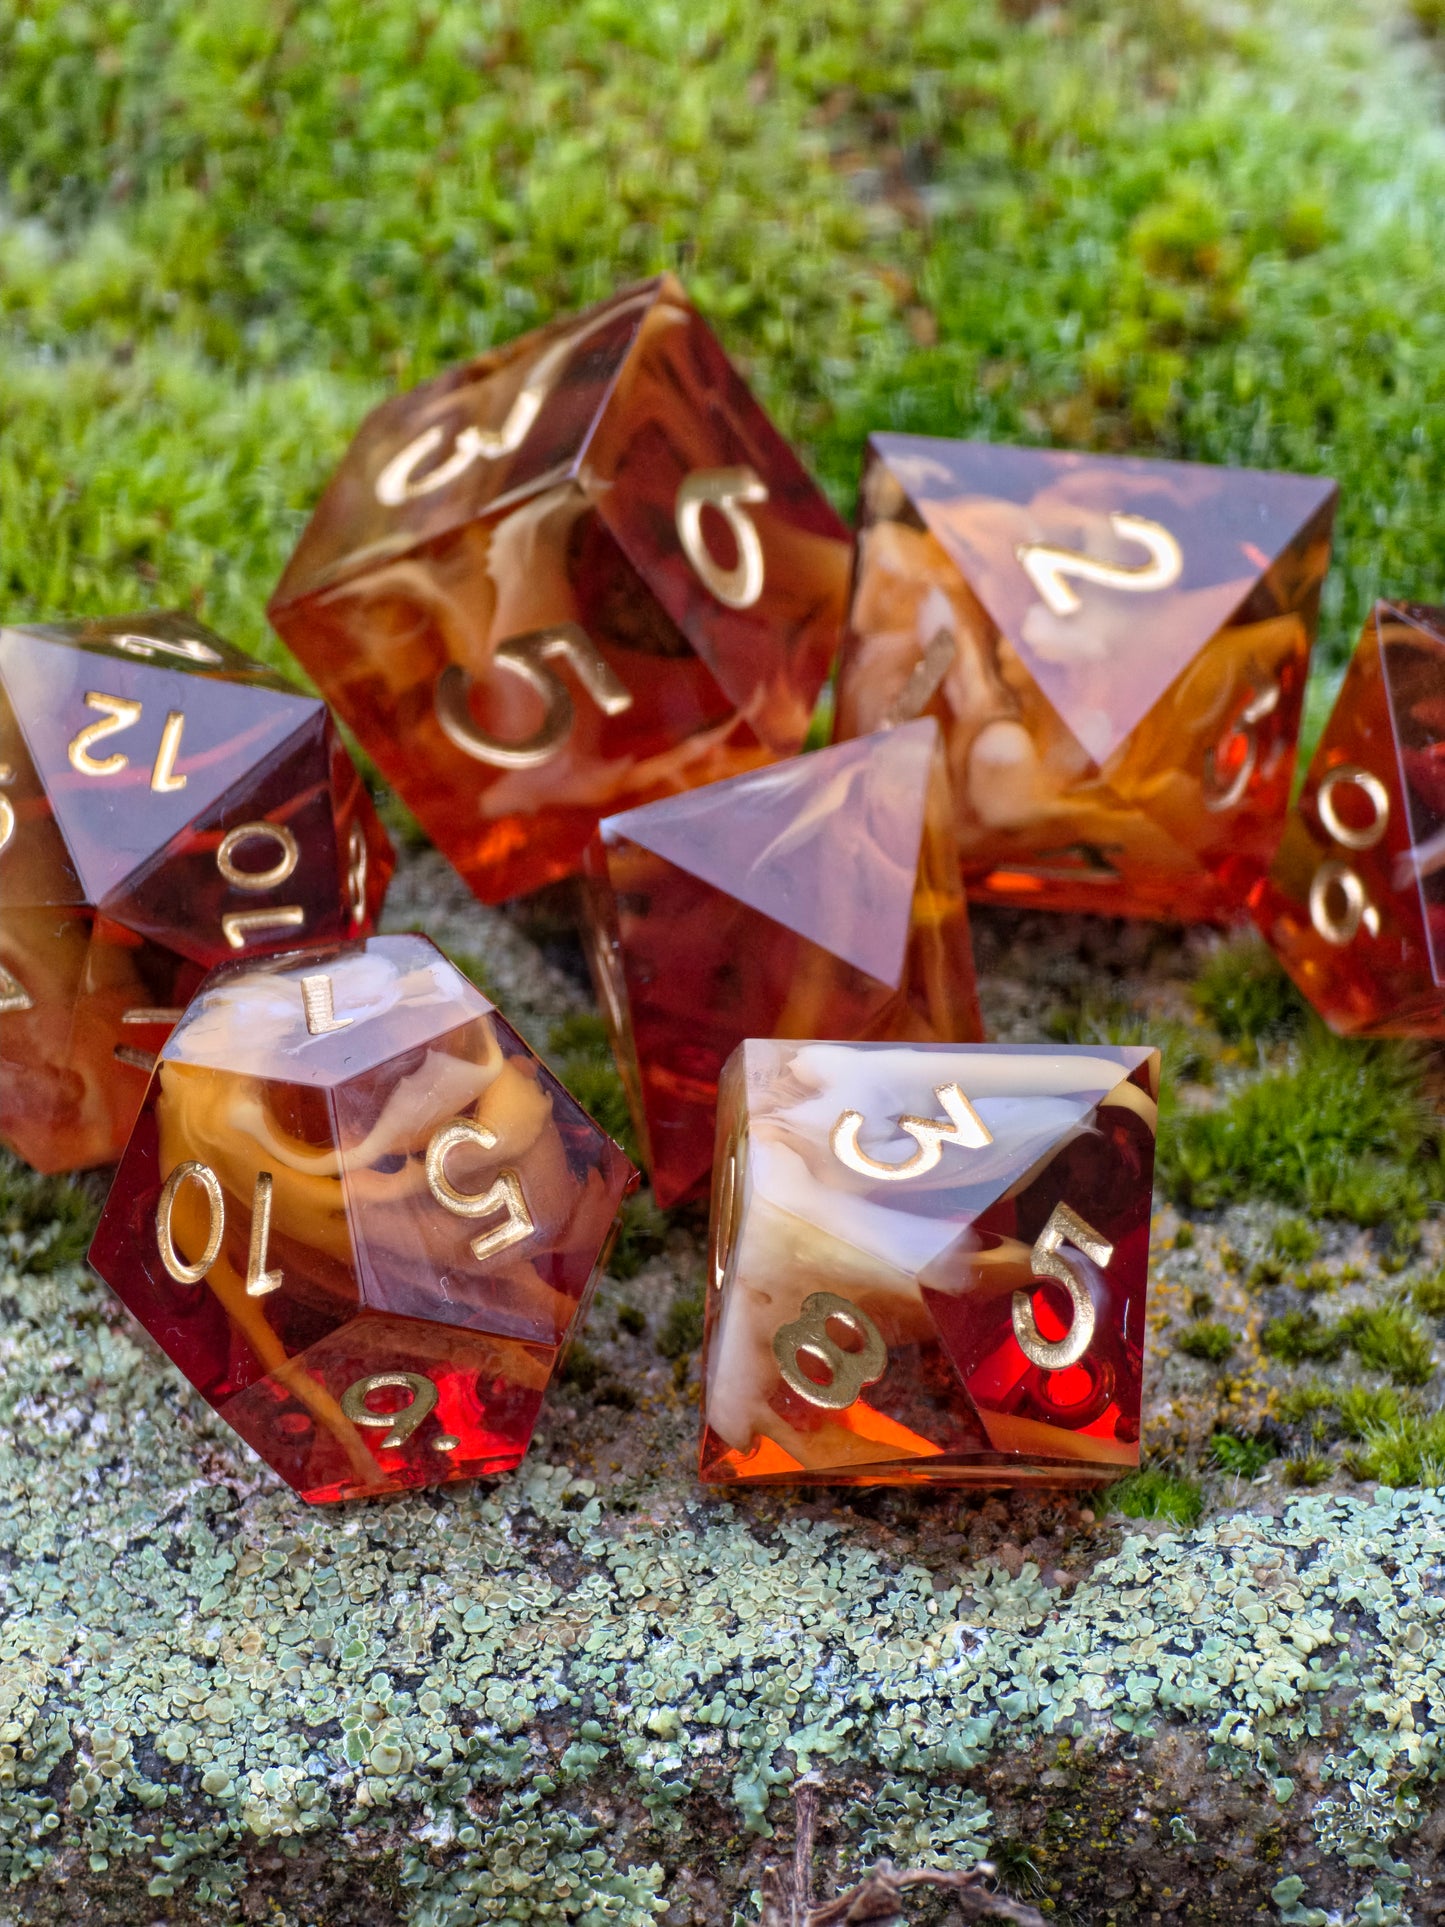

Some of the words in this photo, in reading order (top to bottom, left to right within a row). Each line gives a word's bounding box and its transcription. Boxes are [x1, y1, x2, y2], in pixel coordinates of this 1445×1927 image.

[376, 392, 541, 506] 3
[1017, 511, 1183, 617] 2
[69, 691, 188, 792] 12
[434, 623, 632, 770] 5
[217, 821, 304, 949] 10
[426, 1118, 535, 1262] 5
[833, 1082, 994, 1181] 3
[157, 1160, 284, 1297] 10
[1011, 1202, 1114, 1371] 5
[772, 1292, 888, 1411] 8
